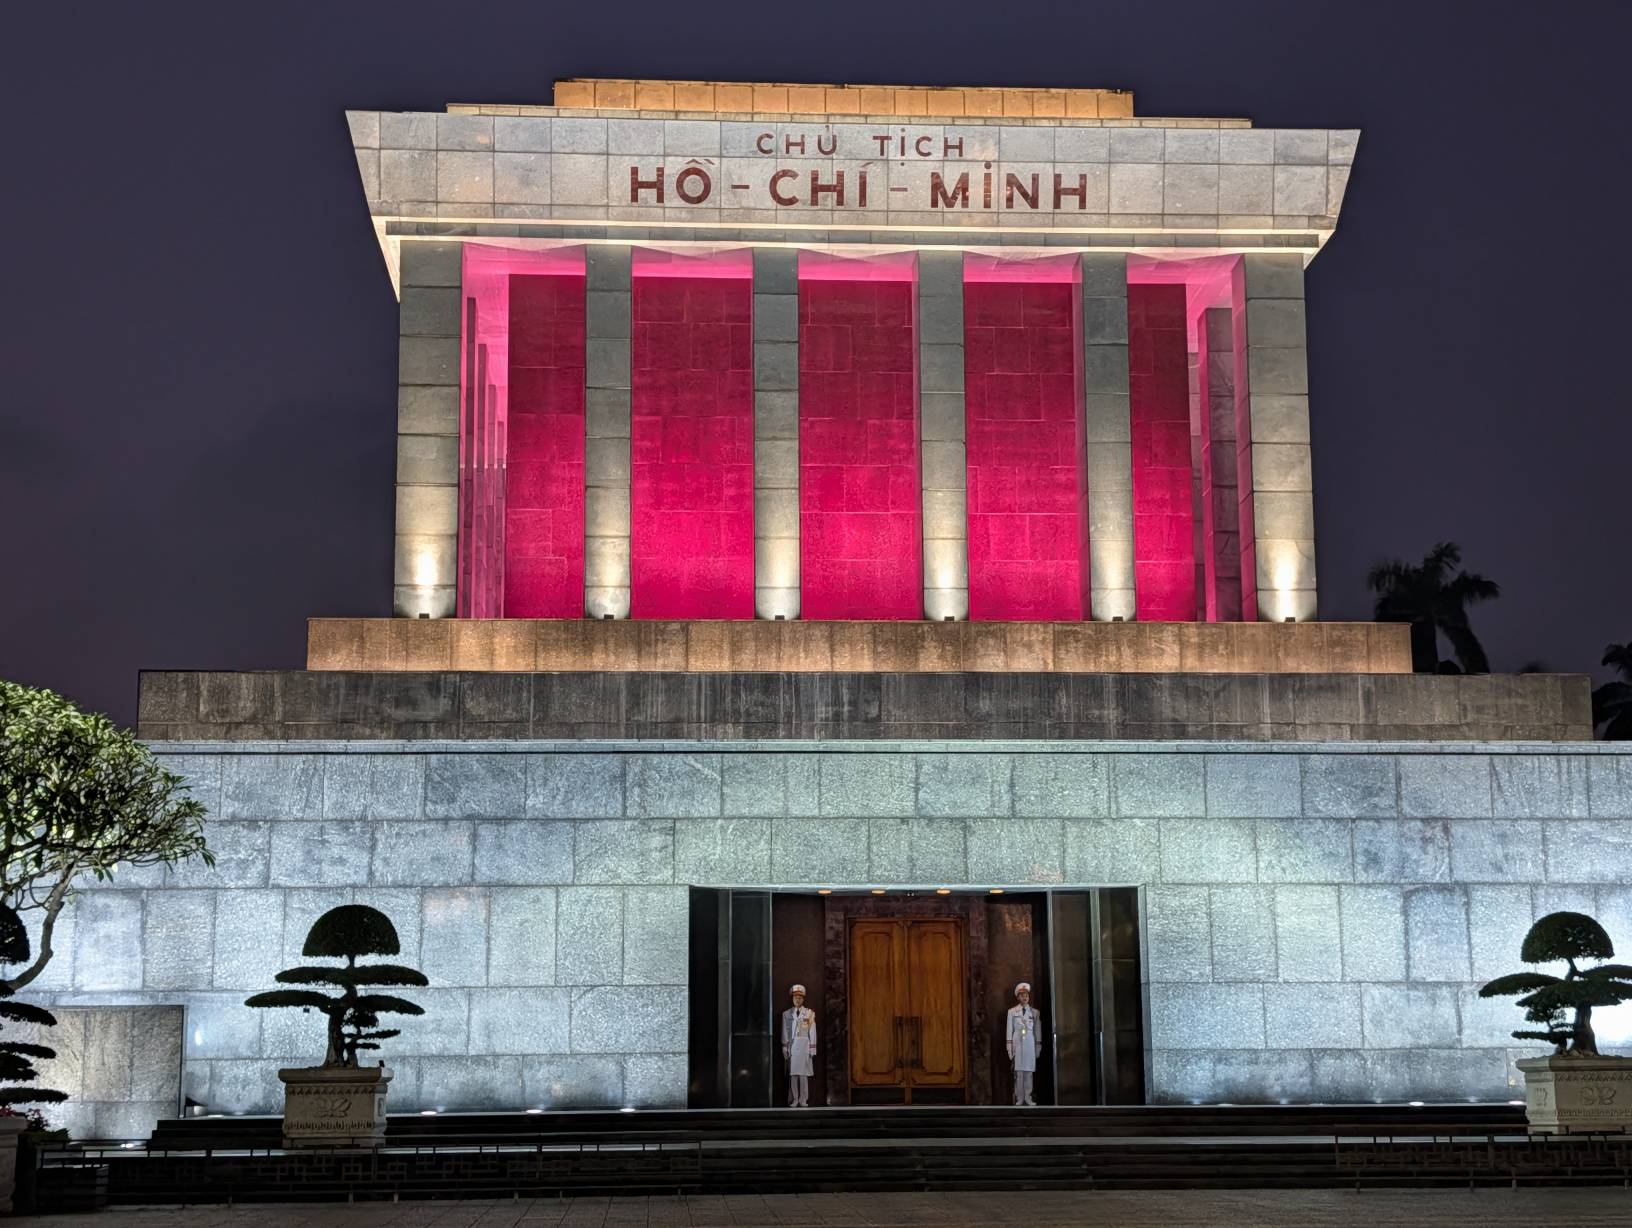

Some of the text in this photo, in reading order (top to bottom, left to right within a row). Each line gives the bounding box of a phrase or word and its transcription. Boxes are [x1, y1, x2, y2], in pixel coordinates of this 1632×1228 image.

[756, 125, 837, 155] CHỦ
[630, 158, 716, 205] HỒ
[769, 161, 874, 207] CHÍ
